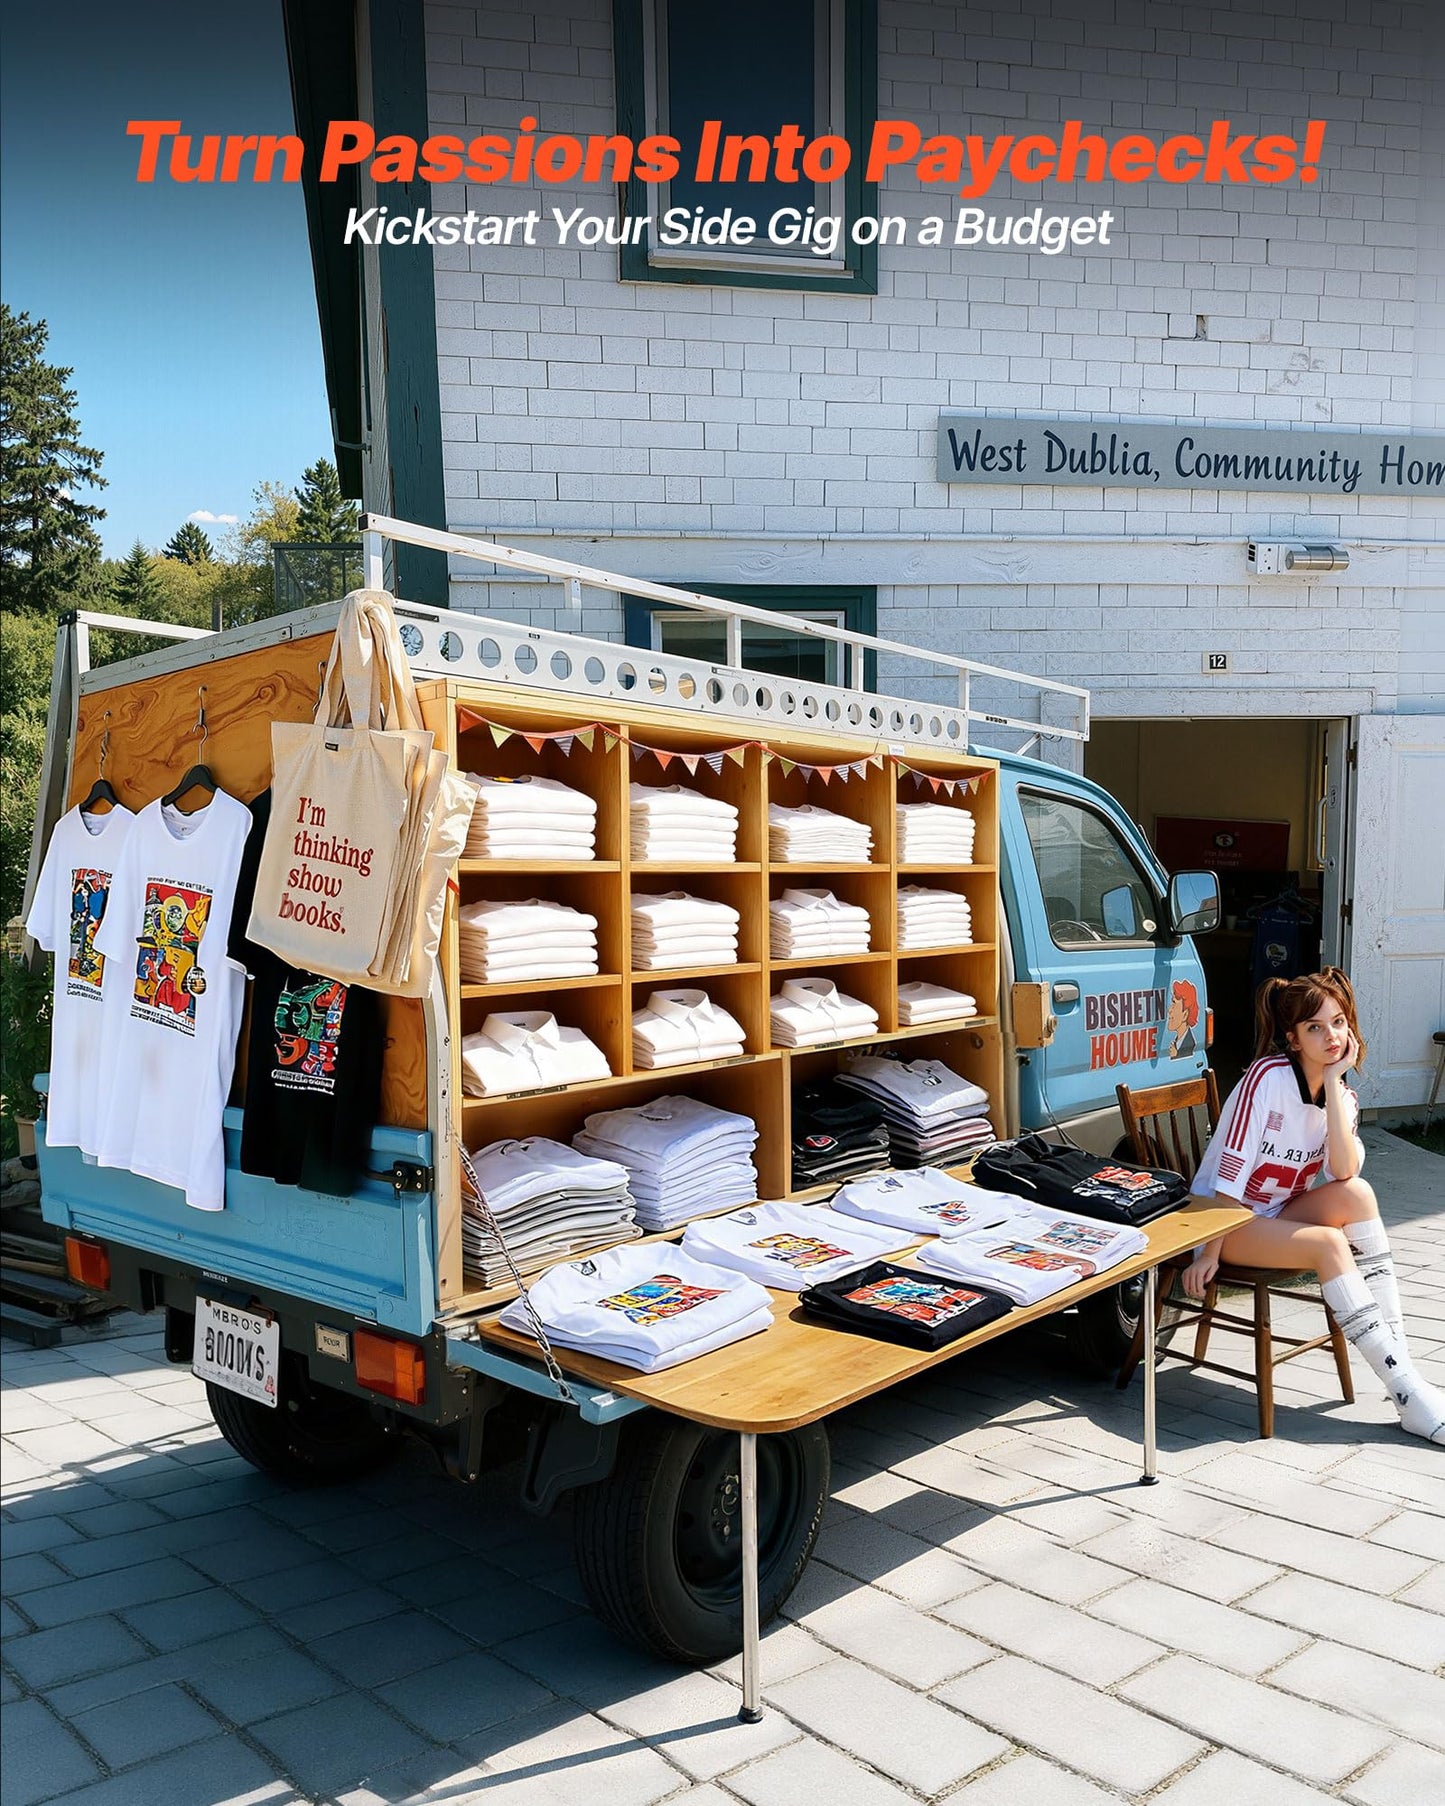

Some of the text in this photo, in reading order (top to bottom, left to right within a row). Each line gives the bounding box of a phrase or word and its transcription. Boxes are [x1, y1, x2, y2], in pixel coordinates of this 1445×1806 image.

[947, 427, 1028, 474] West
[1042, 429, 1161, 482] Dublia,
[1174, 436, 1363, 493] Community
[1210, 655, 1225, 668] 12
[296, 796, 326, 828] I'm
[293, 830, 374, 878] thinking
[287, 863, 343, 899] show
[1084, 988, 1167, 1031] BISHETN
[1089, 1026, 1158, 1071] HOUME
